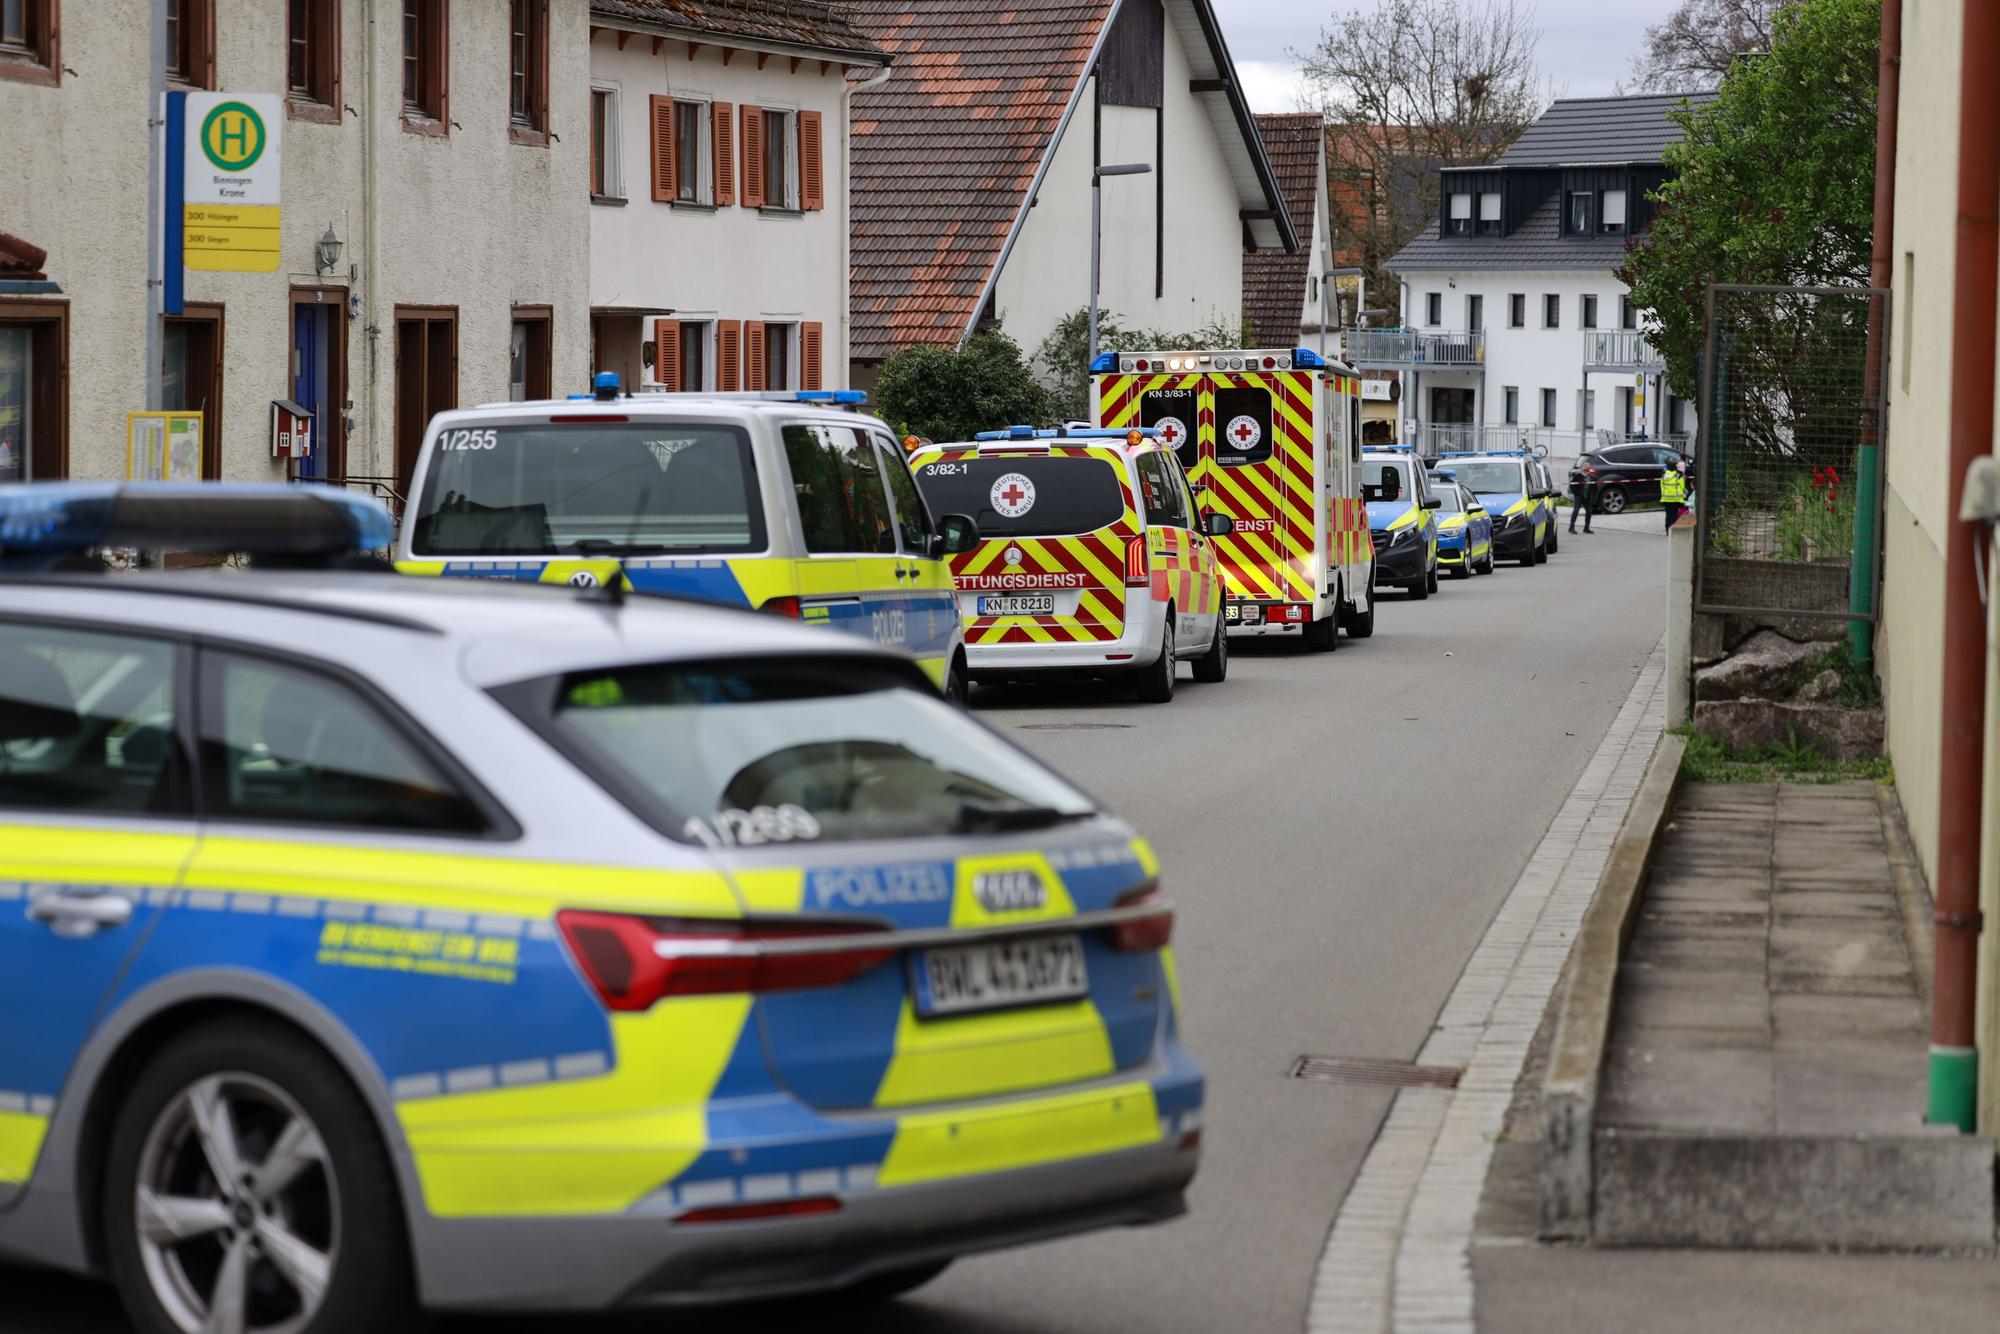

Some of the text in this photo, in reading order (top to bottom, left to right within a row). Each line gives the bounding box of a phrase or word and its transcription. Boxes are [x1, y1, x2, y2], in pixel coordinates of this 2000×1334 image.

[219, 117, 247, 156] H
[213, 175, 253, 187] Binningen
[219, 188, 246, 198] Krone
[188, 211, 205, 220] 300
[188, 234, 205, 243] 300
[1148, 389, 1192, 398] KN 3/83-1
[1228, 417, 1258, 430] DEUTSCHES
[439, 429, 498, 451] 1/255
[926, 463, 968, 476] 3/82-1
[994, 475, 1032, 491] DEUTSCHES
[993, 496, 1011, 515] ROTES
[1014, 495, 1034, 515] KREUZ
[952, 573, 1087, 589] ETTUNGSDIENST
[986, 597, 1051, 610] KN R 8218
[871, 609, 906, 645] POLIZEI
[812, 864, 949, 908] POLIZEI
